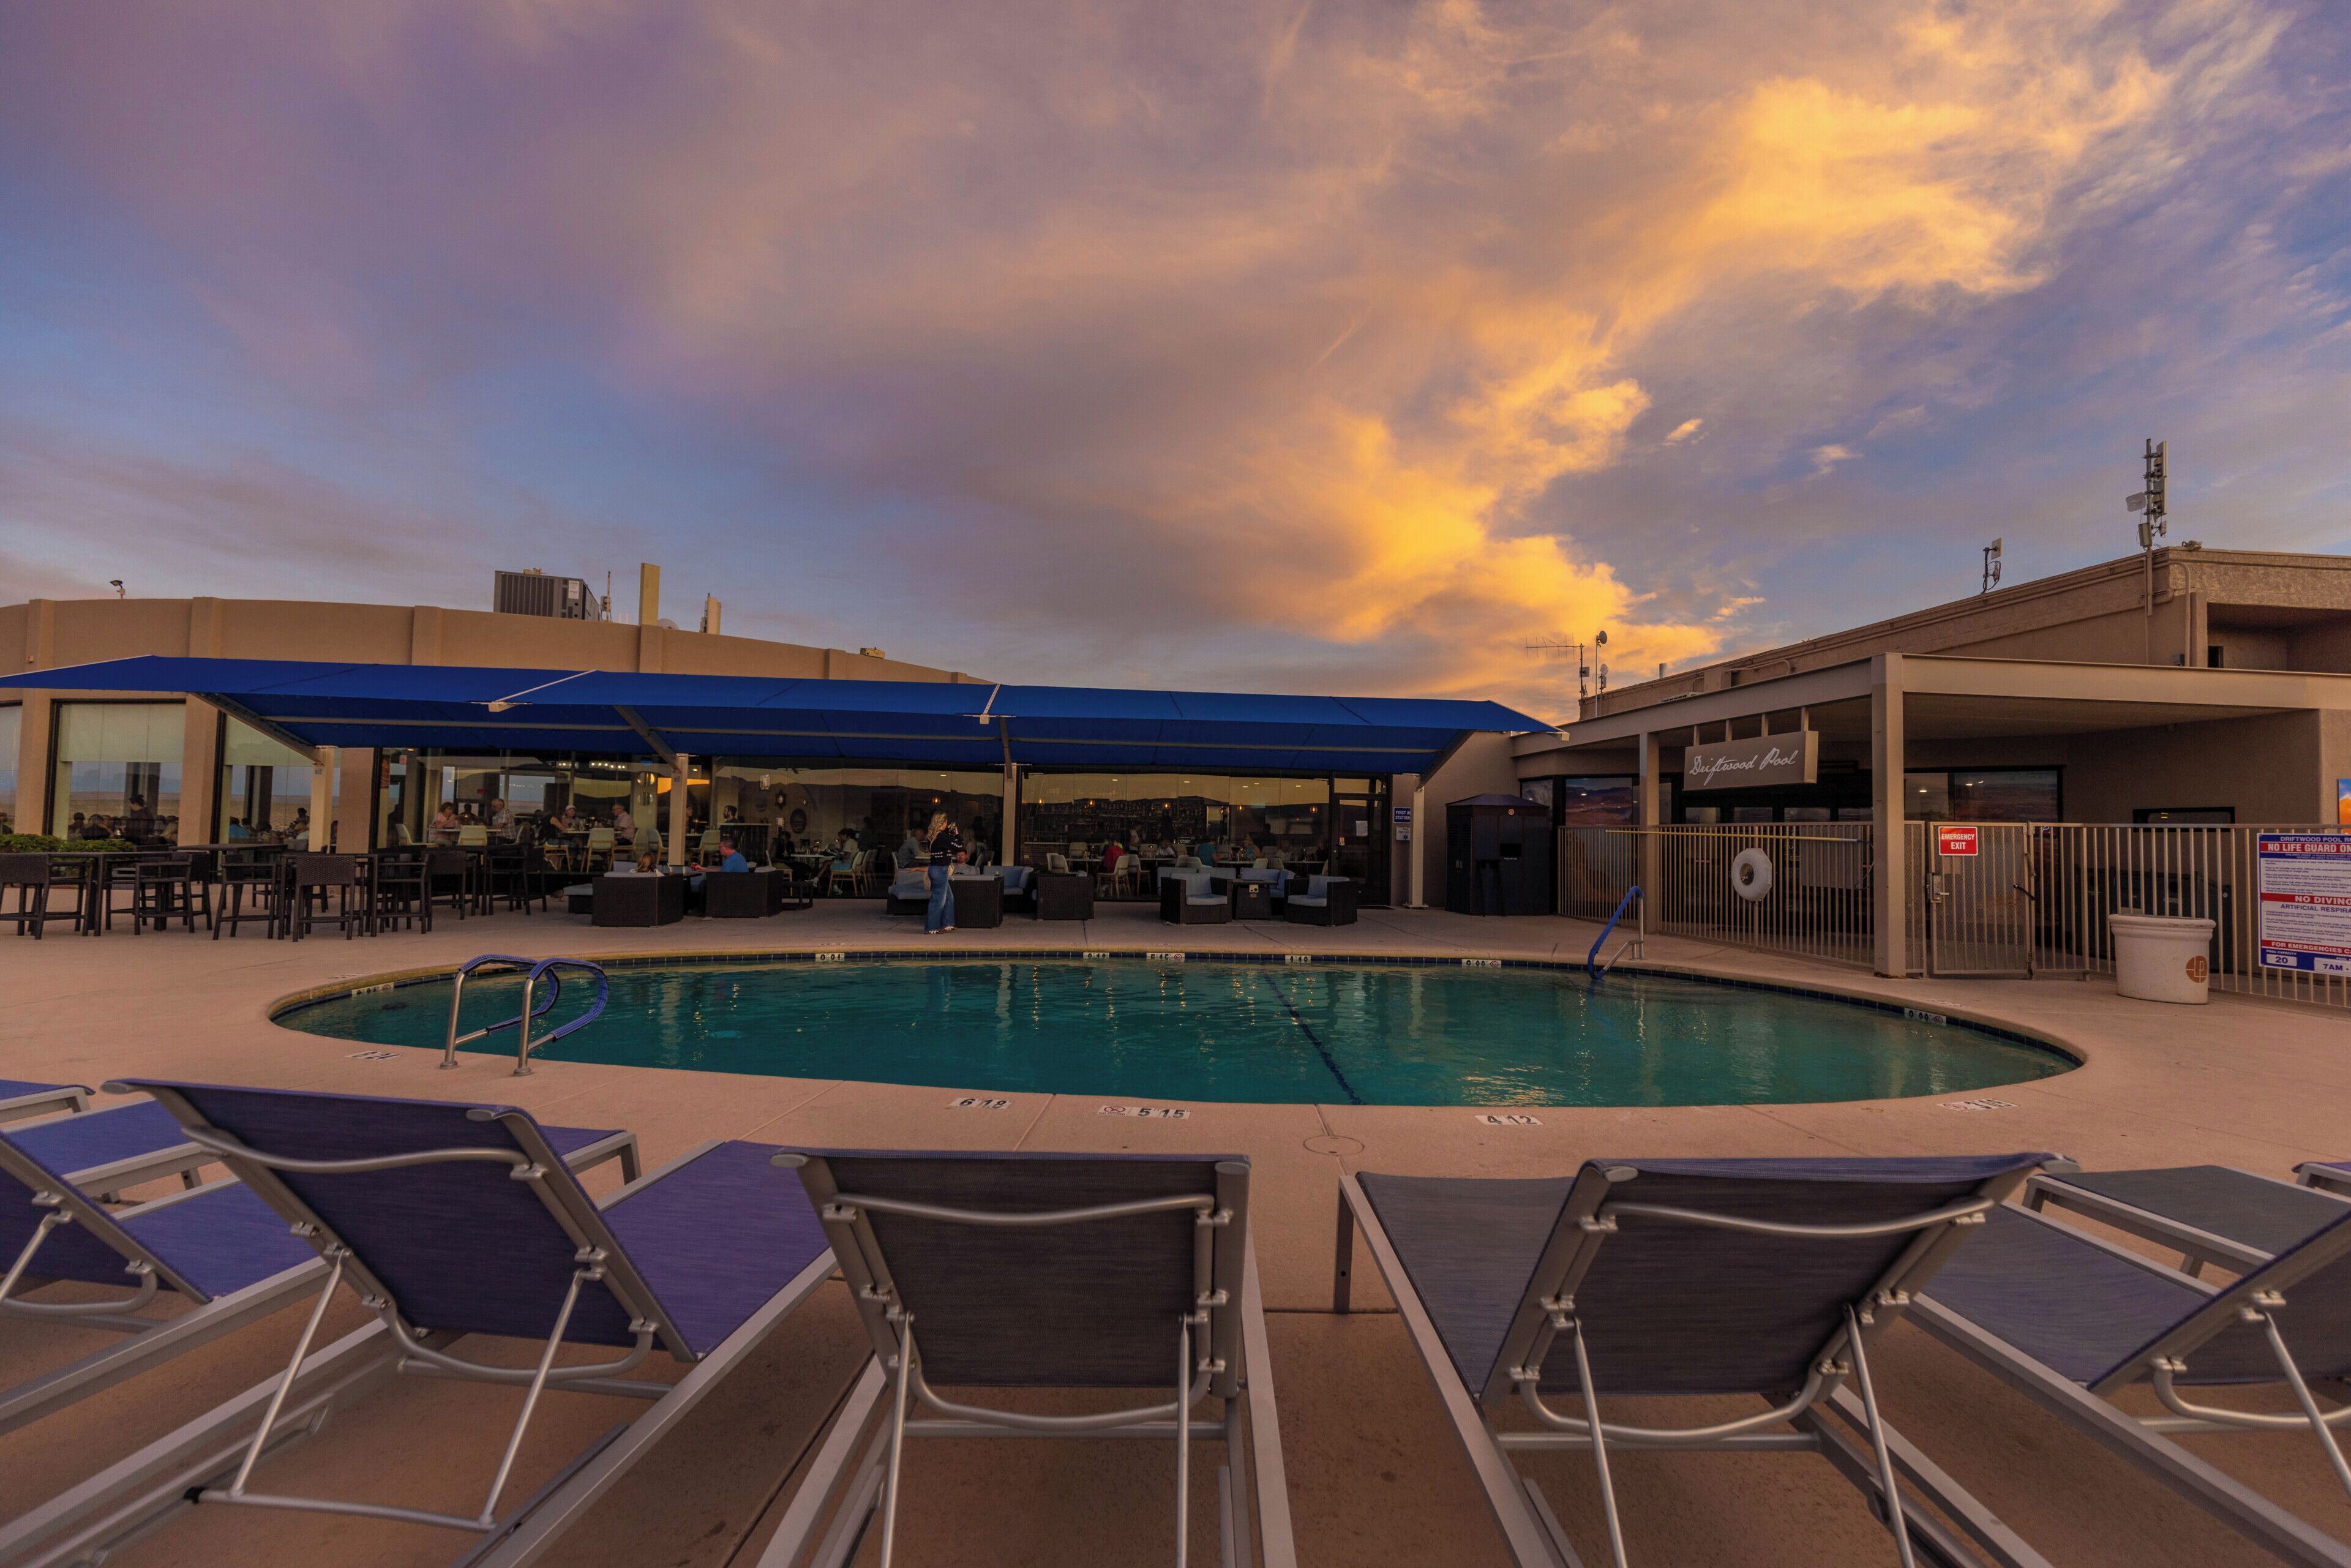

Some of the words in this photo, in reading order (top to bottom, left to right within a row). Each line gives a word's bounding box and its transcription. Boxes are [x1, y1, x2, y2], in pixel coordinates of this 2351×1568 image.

[1689, 755, 1758, 786] Driftwood
[1759, 748, 1798, 770] Pool
[2304, 844, 2337, 852] GUARD
[2314, 896, 2351, 906] DIVING
[2288, 943, 2342, 953] EMERGENCIES
[1138, 1108, 1152, 1117] 5
[1487, 1116, 1502, 1125] 4
